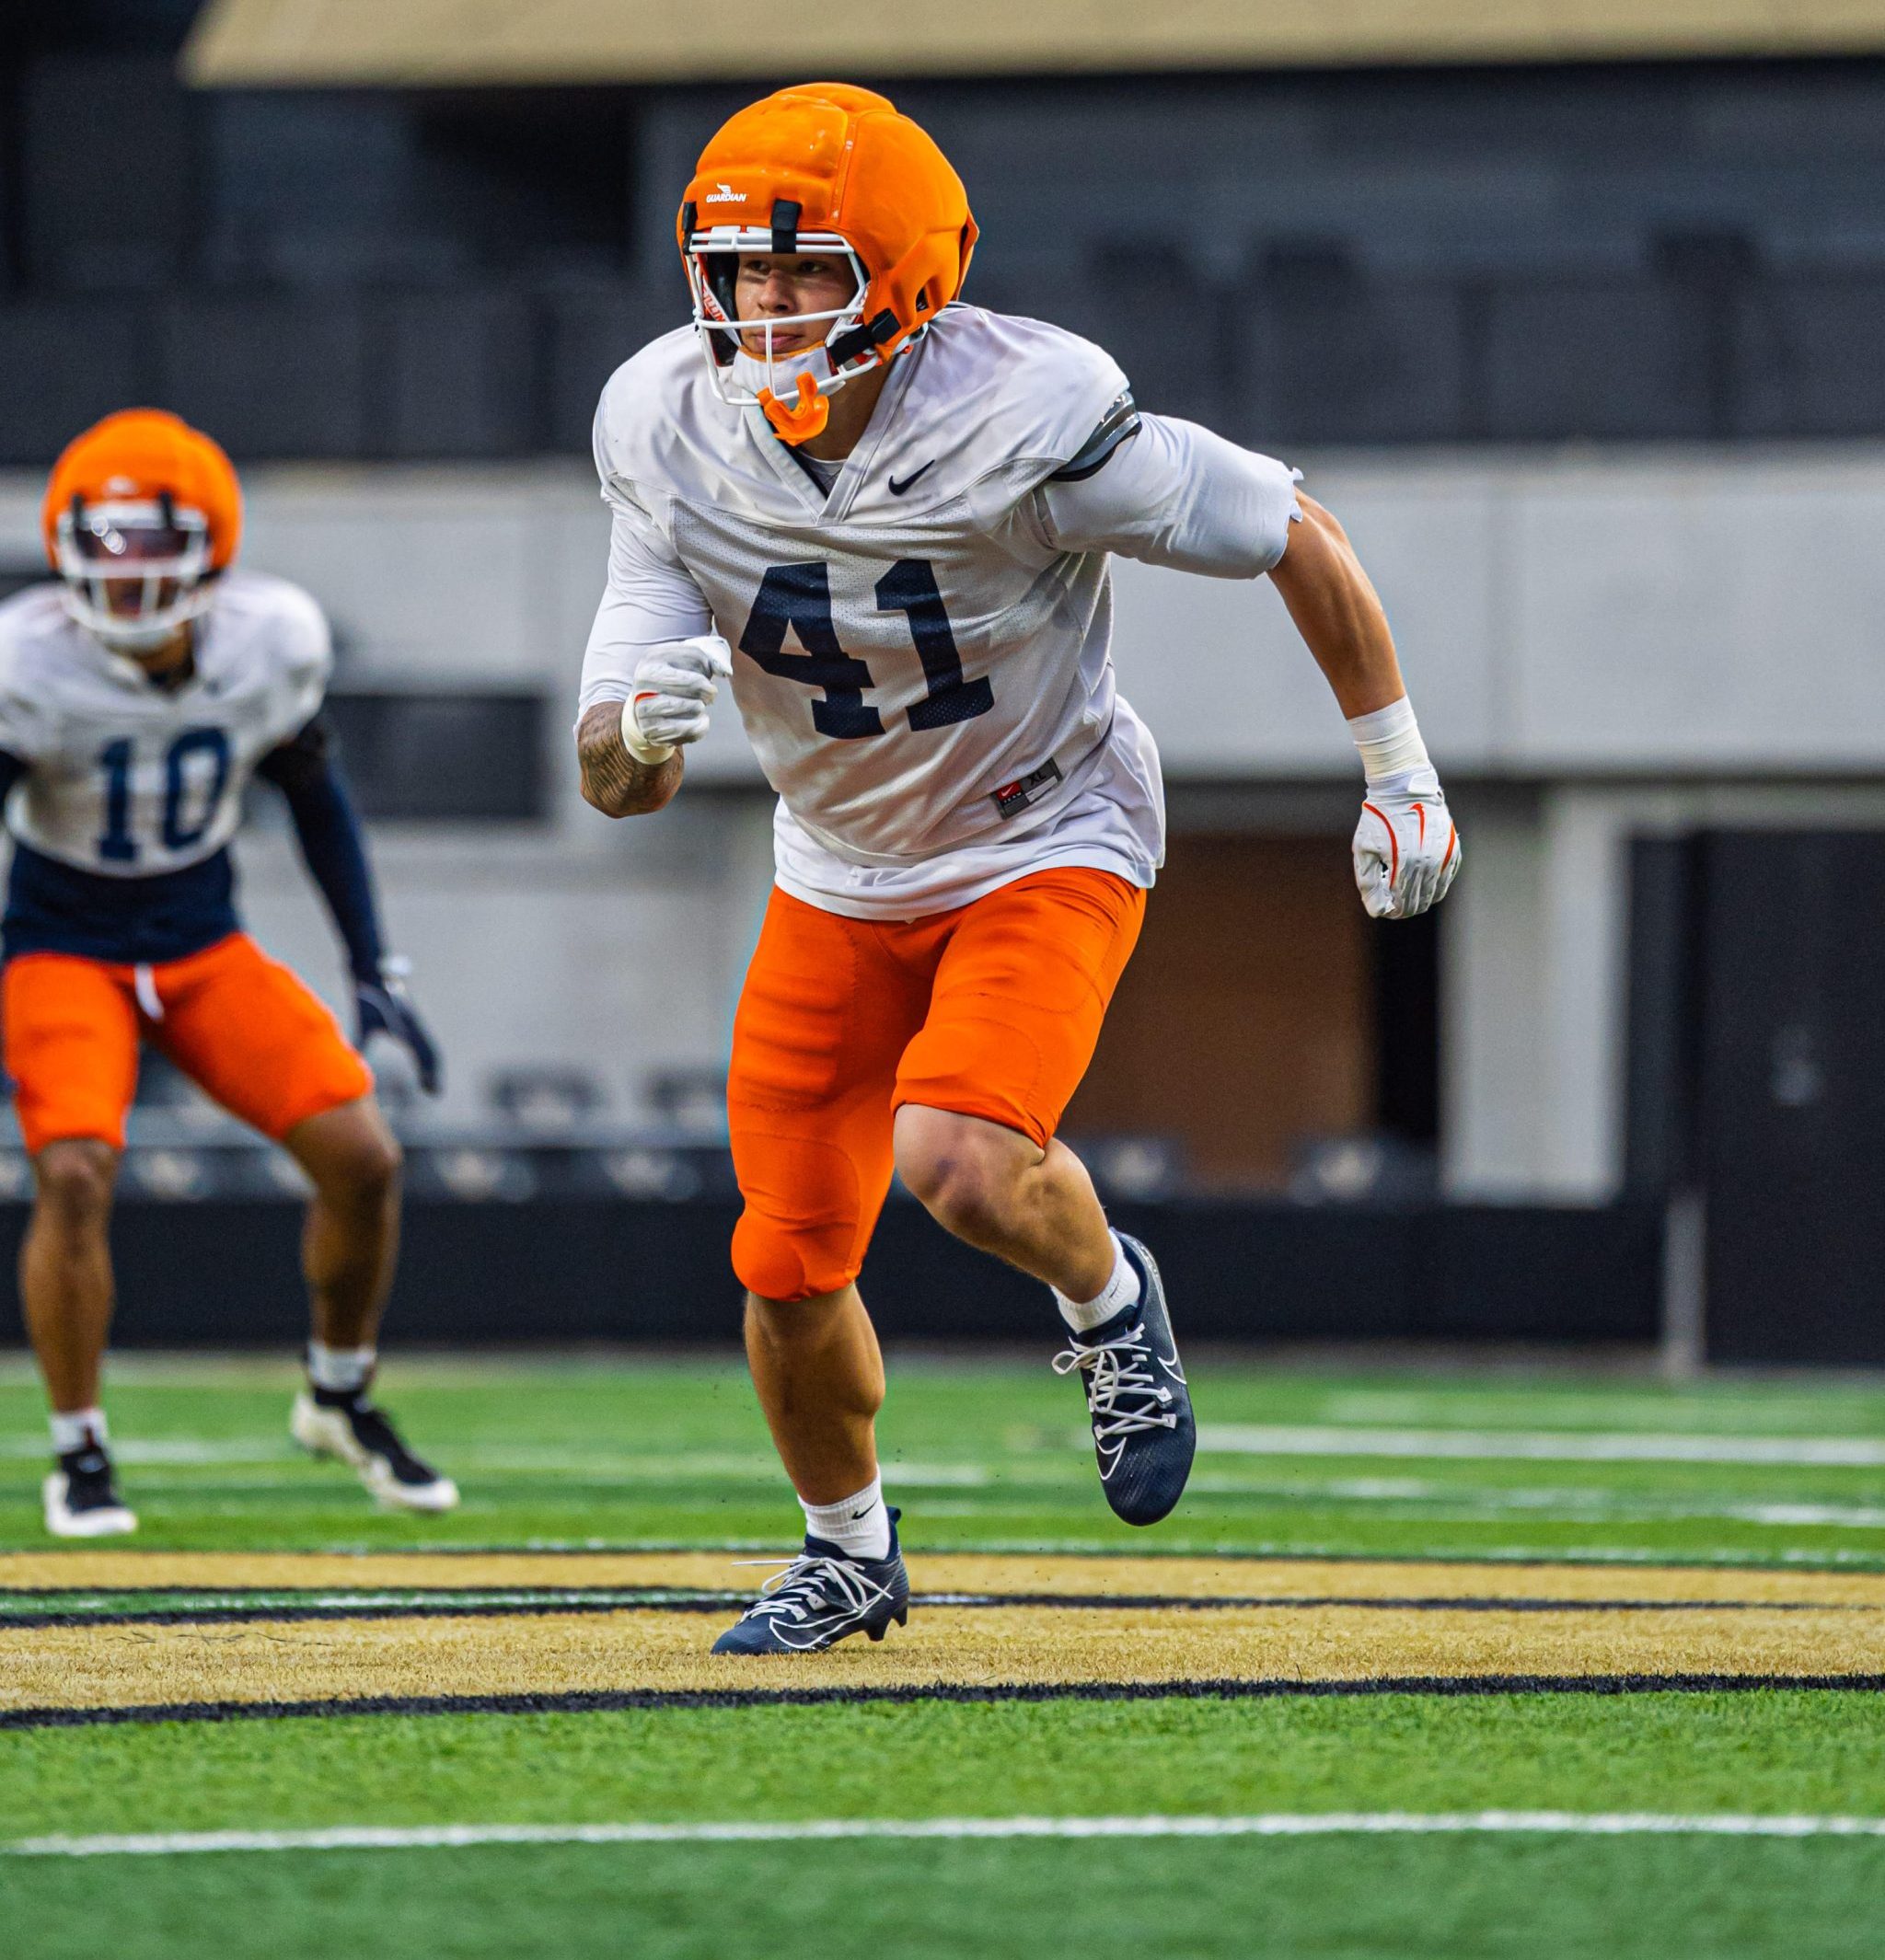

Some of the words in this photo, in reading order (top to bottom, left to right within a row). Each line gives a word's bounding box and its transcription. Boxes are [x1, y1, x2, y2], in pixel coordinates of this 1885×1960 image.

[705, 192, 747, 203] GUARDIAN
[738, 559, 994, 740] 41
[98, 726, 228, 859] 10
